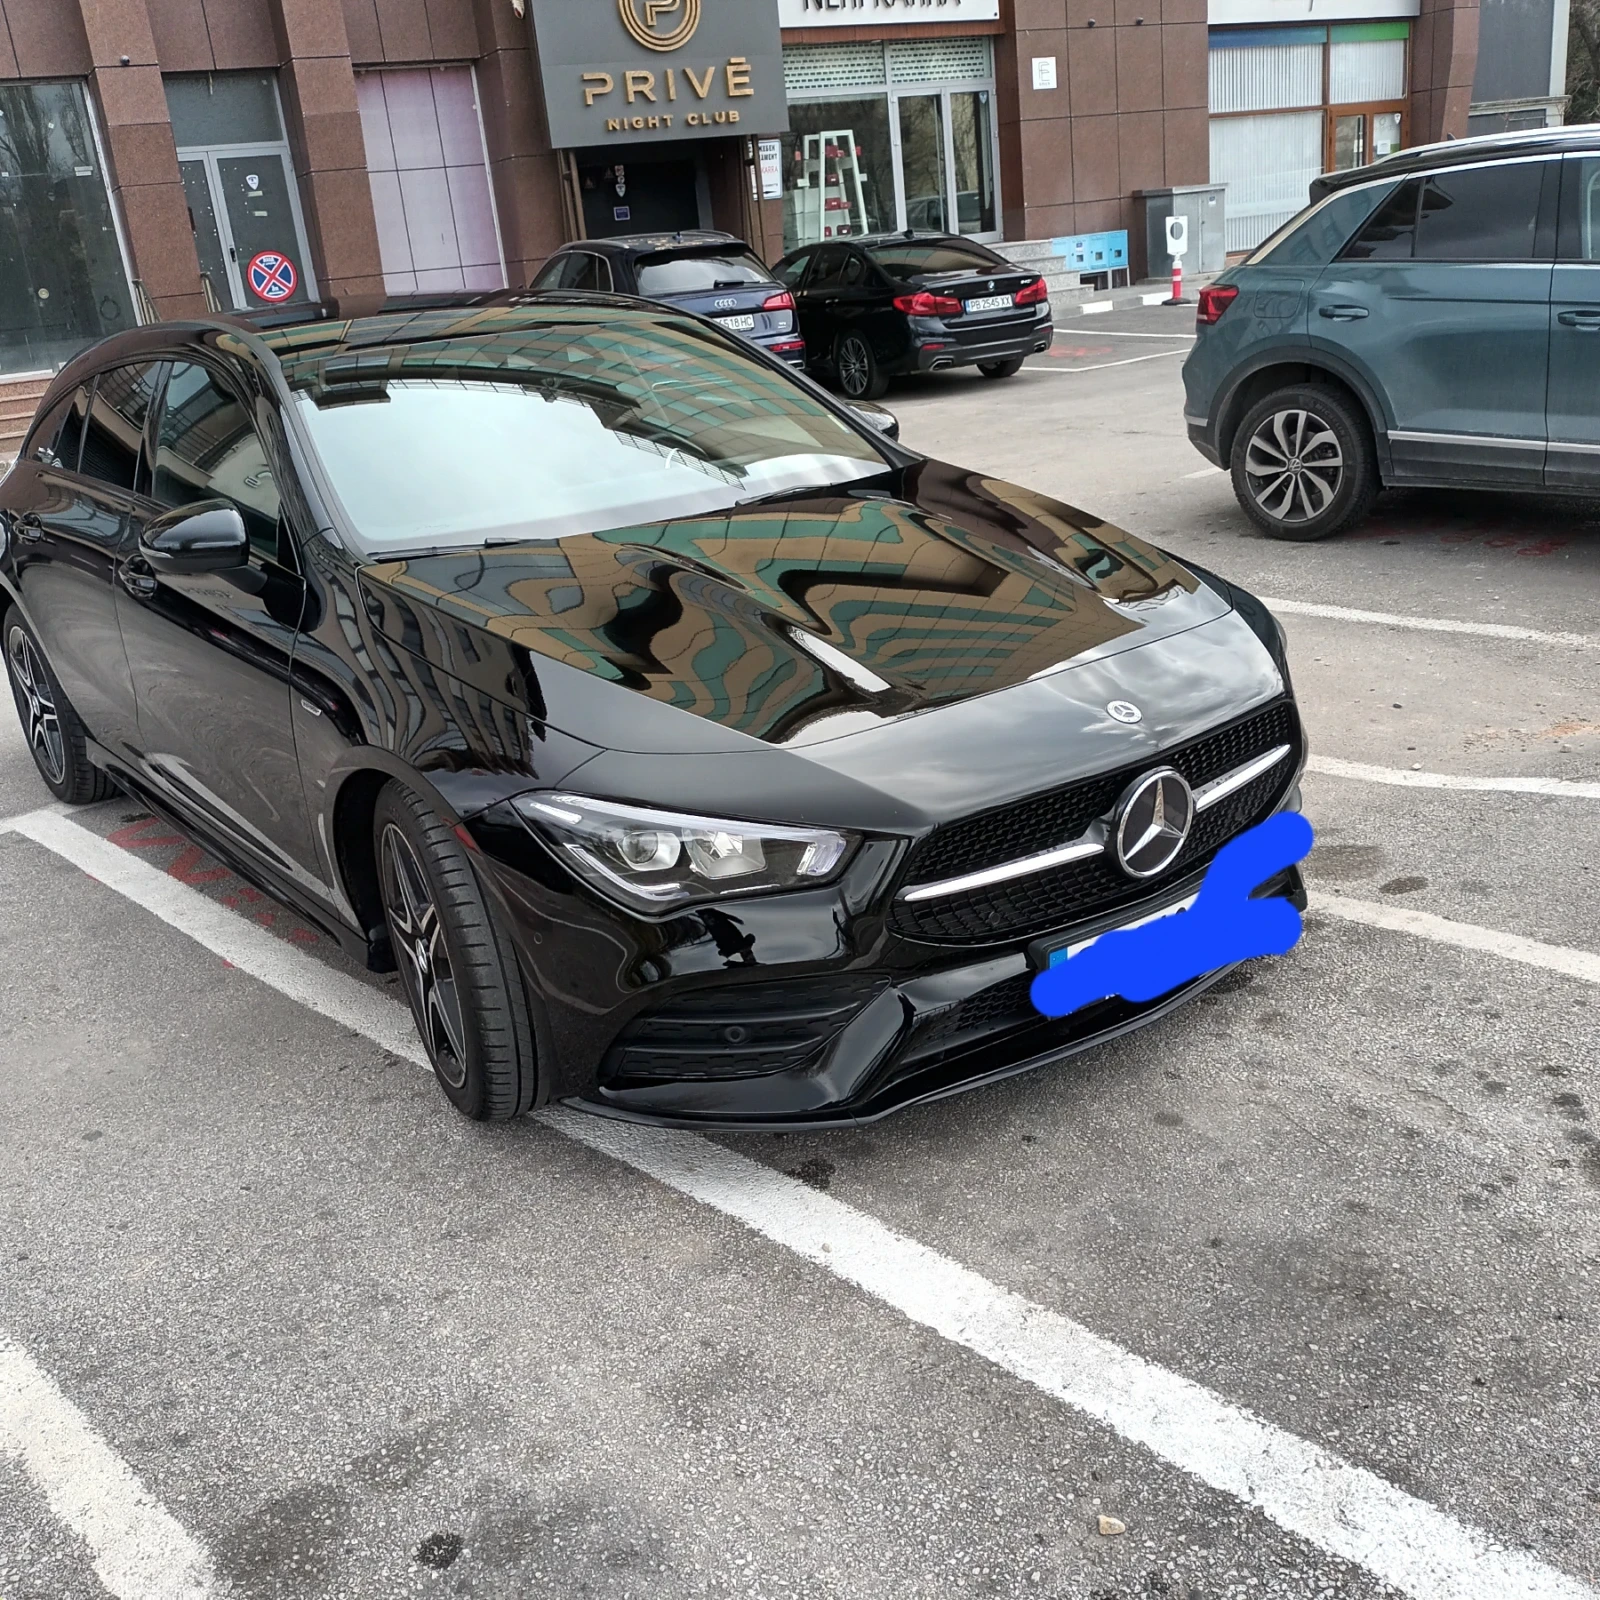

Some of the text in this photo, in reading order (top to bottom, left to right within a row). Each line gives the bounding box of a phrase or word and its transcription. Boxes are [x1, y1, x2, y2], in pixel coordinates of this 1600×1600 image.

[606, 110, 740, 131] NIGHT CLUB
[981, 298, 999, 309] 2545
